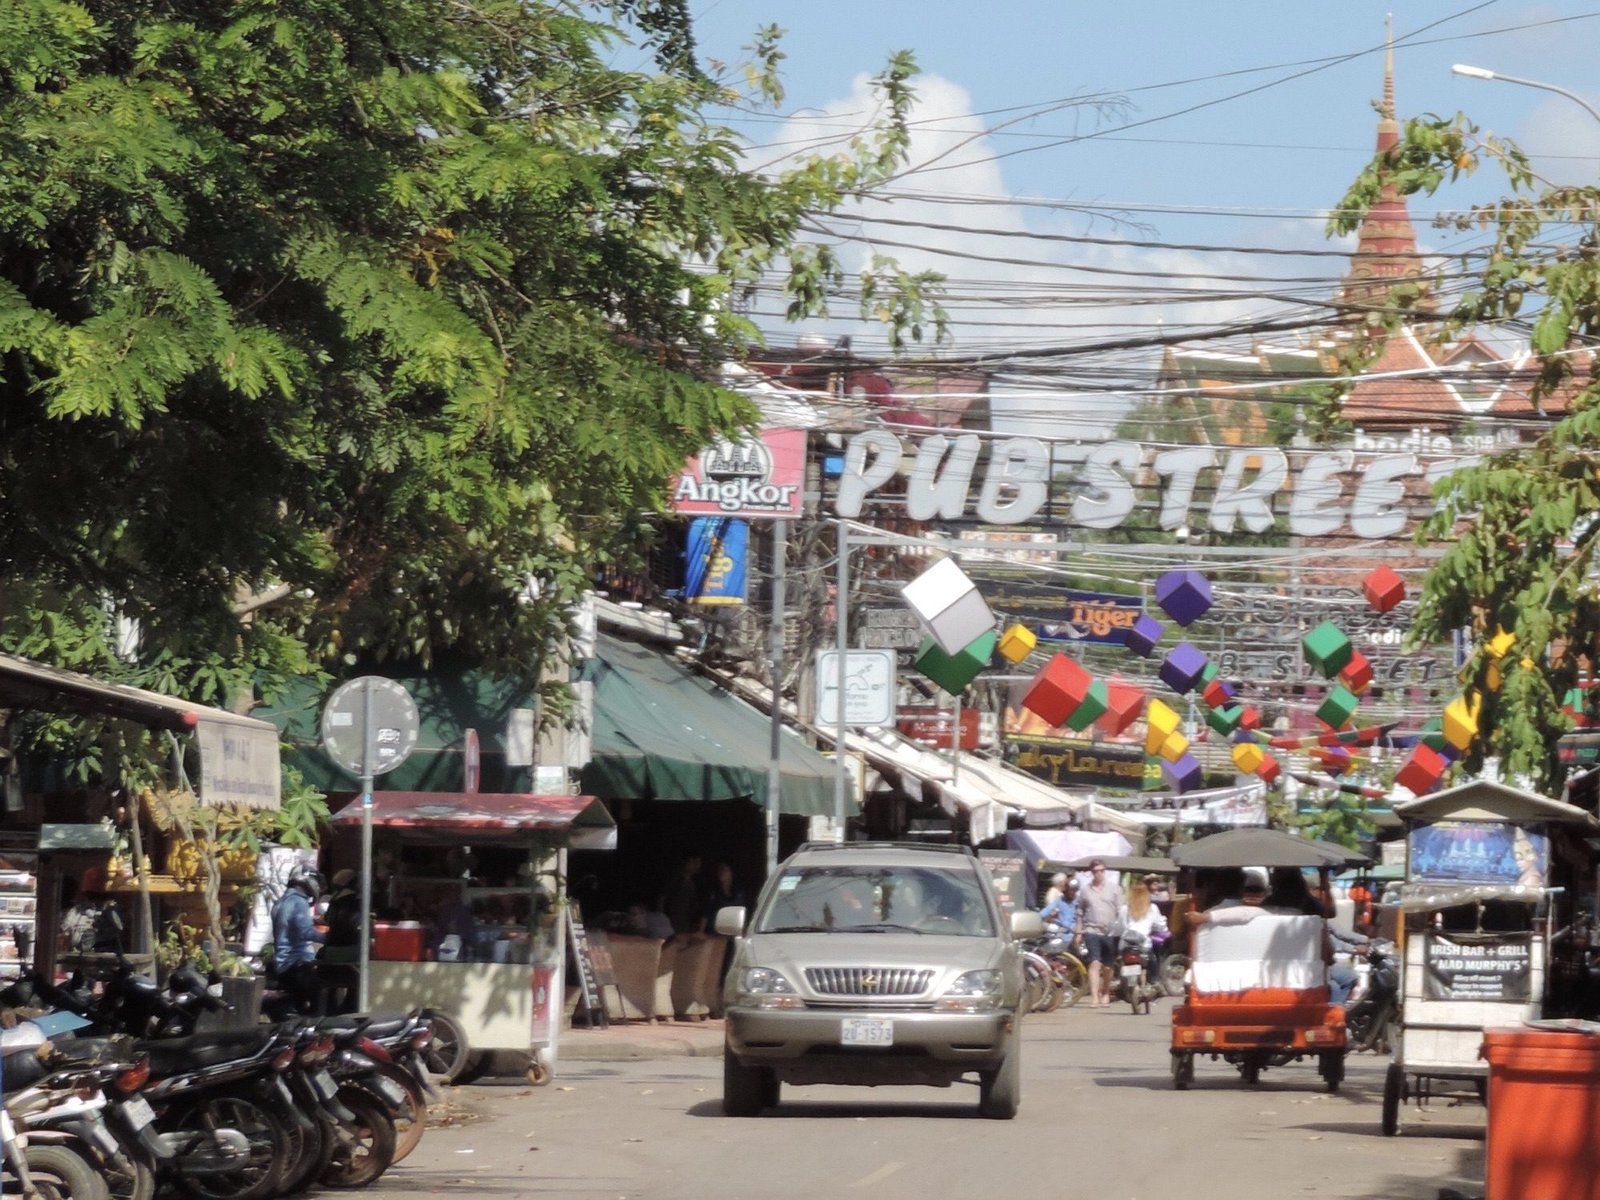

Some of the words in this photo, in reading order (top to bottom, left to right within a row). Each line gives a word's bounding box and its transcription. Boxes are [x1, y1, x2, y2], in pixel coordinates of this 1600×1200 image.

[674, 473, 799, 511] Angkor
[834, 429, 1051, 525] PUB
[703, 536, 734, 594] Tig
[1069, 600, 1139, 637] Tiger
[1430, 945, 1461, 955] IRISH
[1462, 946, 1486, 956] BAR
[1497, 945, 1529, 956] GRILL
